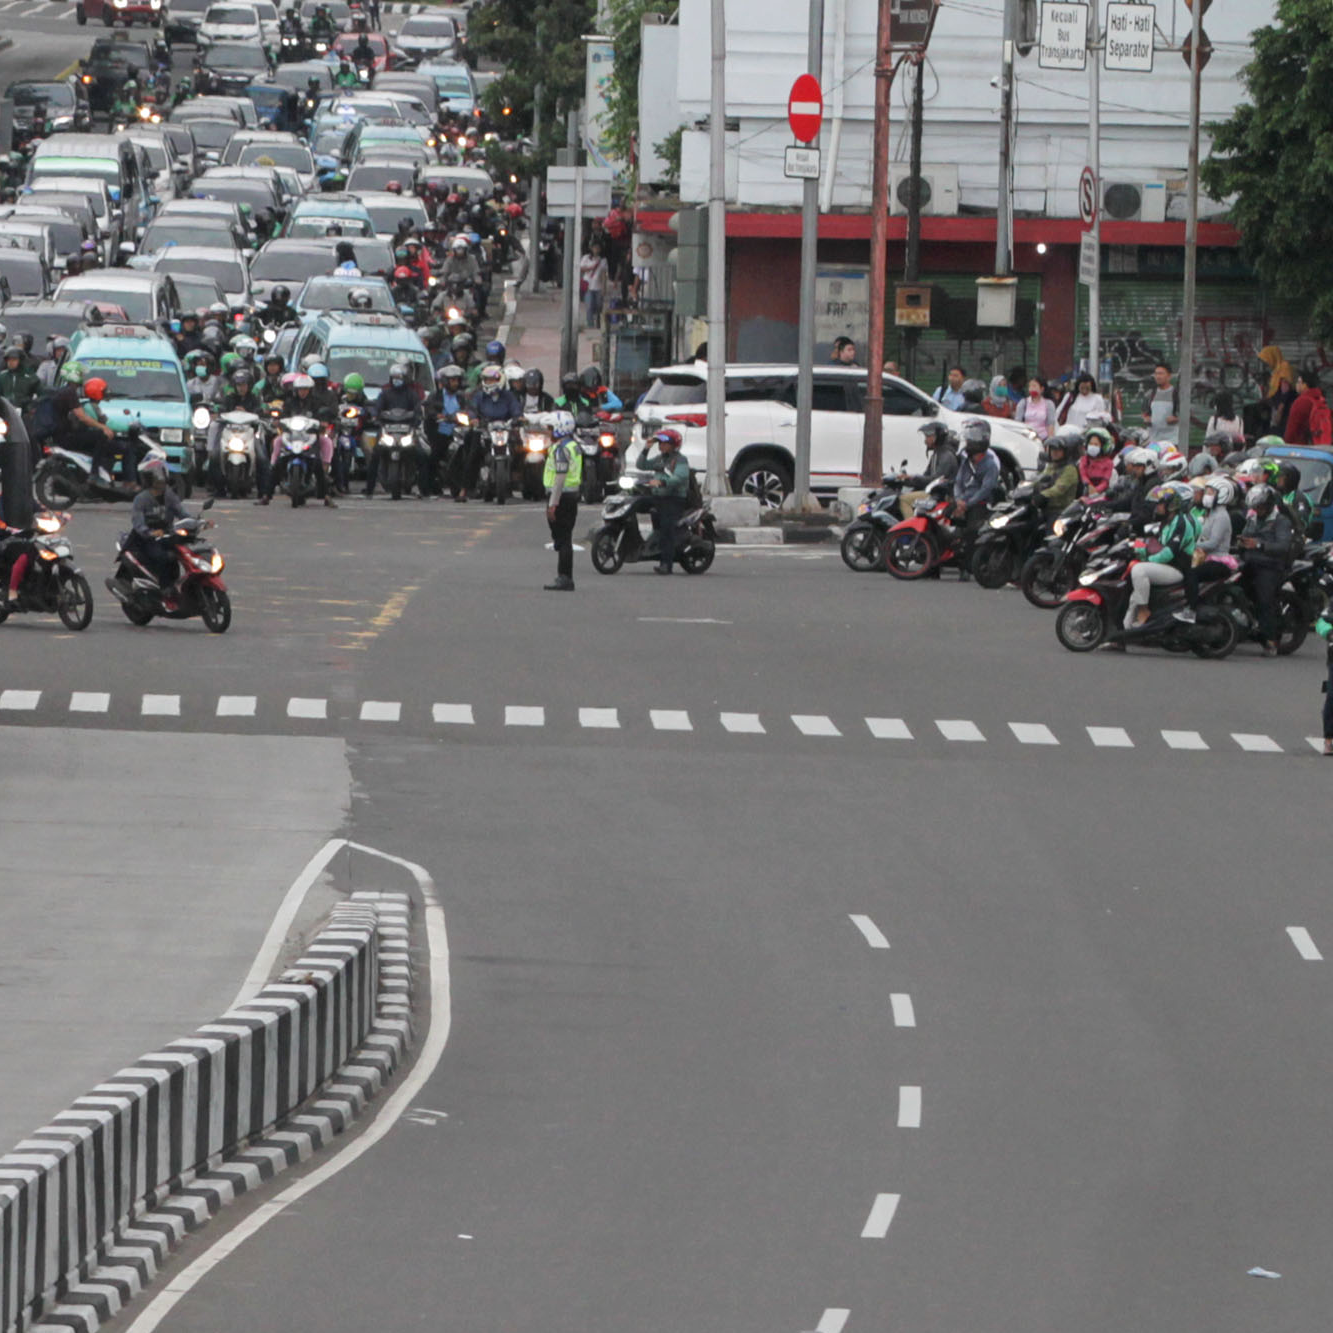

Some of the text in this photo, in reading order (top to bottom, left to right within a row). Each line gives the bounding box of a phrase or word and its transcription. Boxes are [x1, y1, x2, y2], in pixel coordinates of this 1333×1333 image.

[1051, 9, 1078, 23] Kecuali
[1111, 12, 1128, 31] Hati
[1134, 14, 1151, 32] Hati
[1058, 28, 1070, 41] Bus
[1041, 44, 1084, 62] Transjakarta
[1109, 40, 1149, 60] Separator
